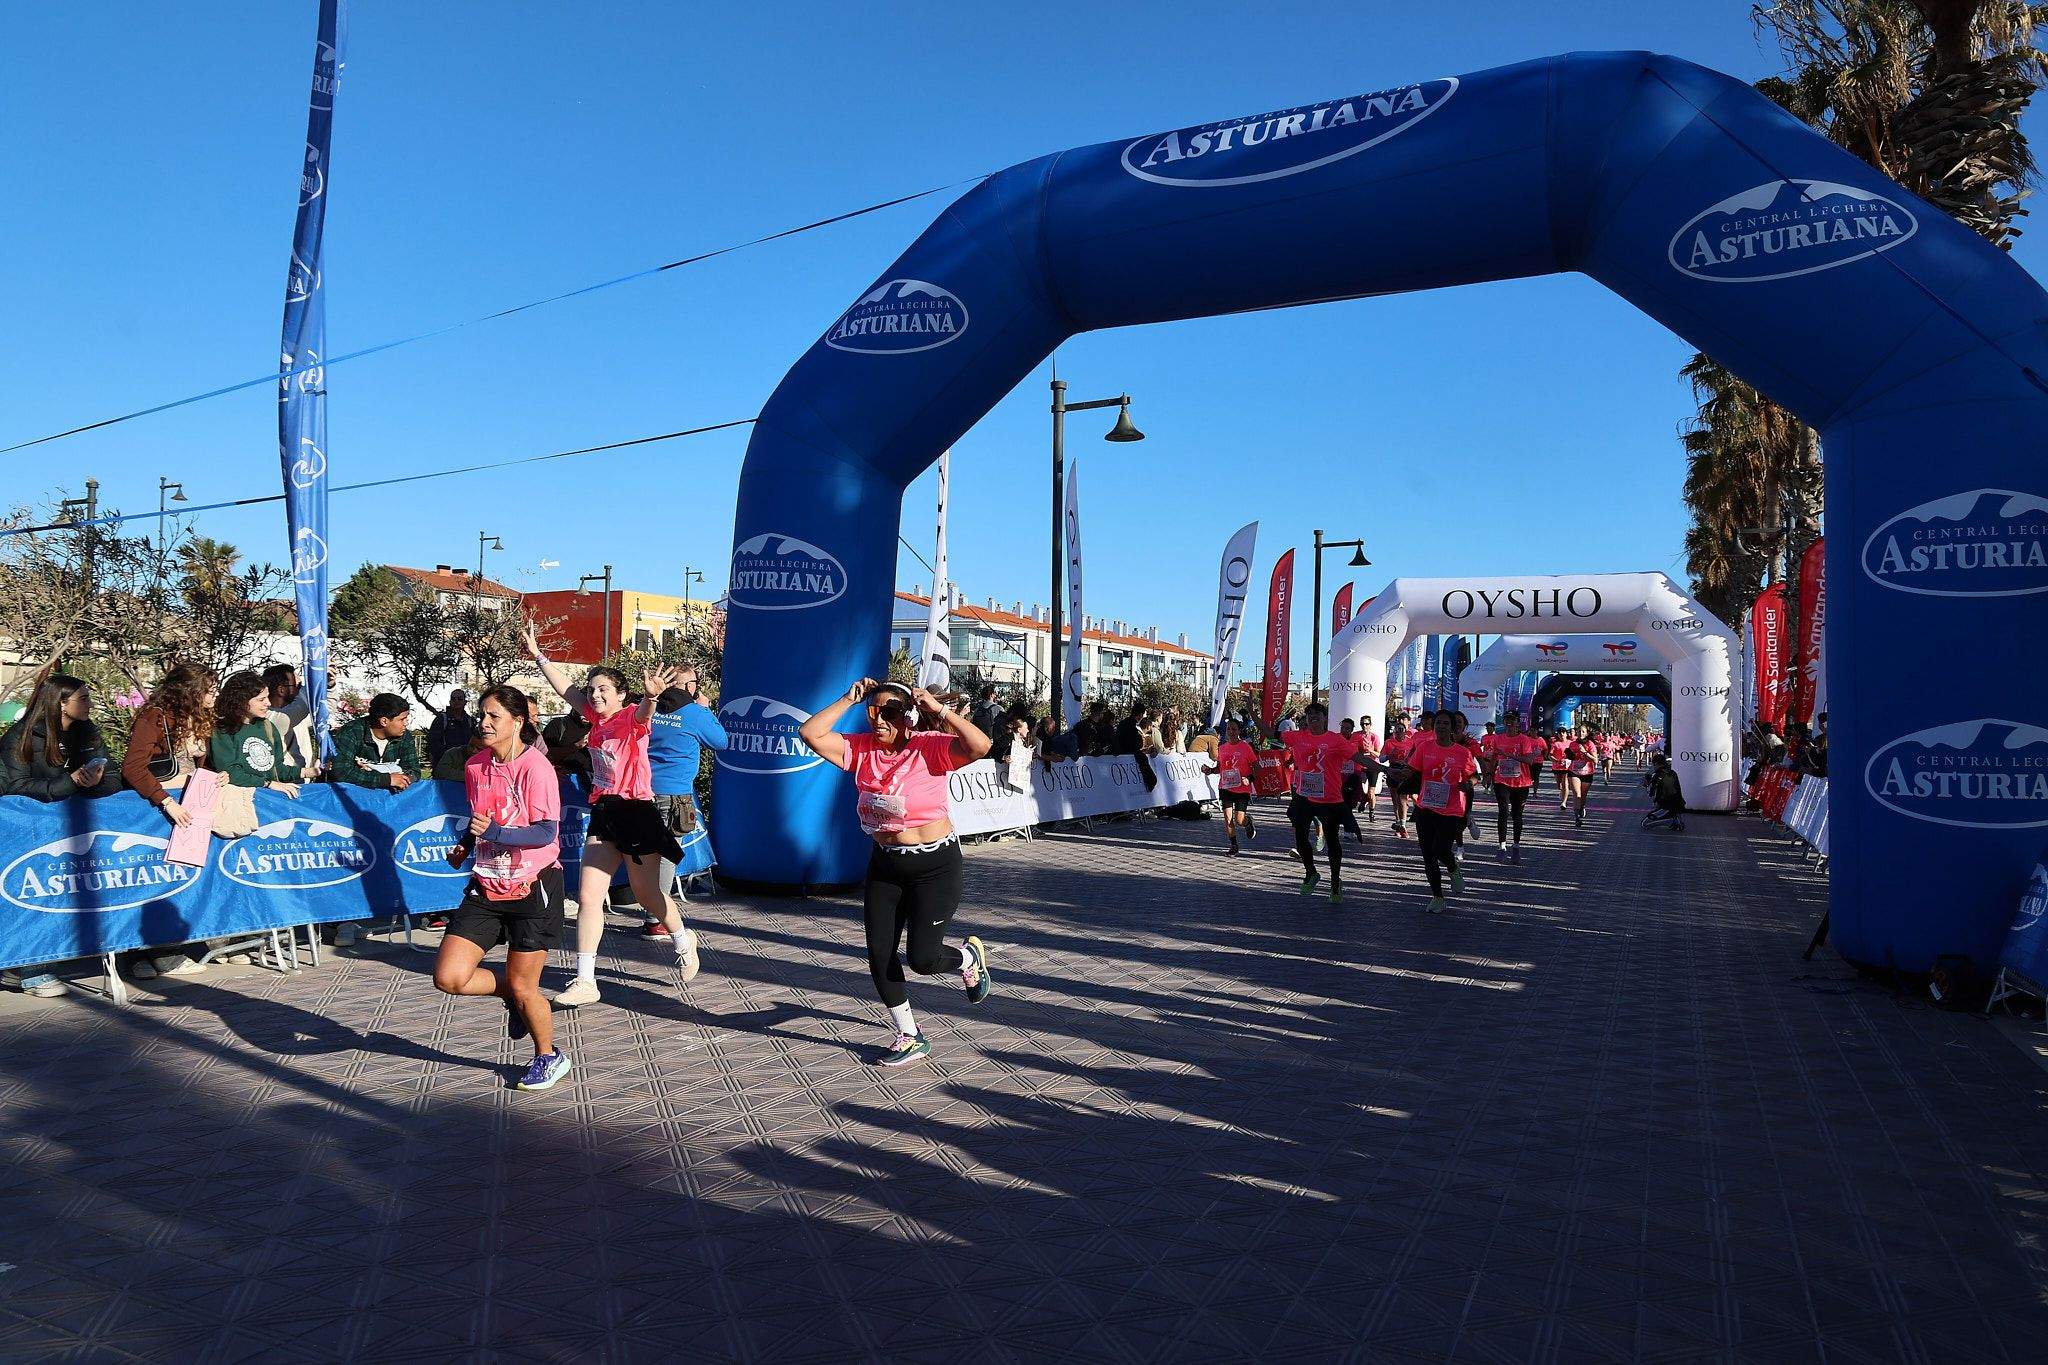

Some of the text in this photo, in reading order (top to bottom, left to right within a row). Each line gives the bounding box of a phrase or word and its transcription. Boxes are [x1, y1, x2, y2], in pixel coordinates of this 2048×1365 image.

[1140, 88, 1428, 169] ASTURIANA
[1721, 203, 1889, 232] CENTRAL LECHERA
[1688, 214, 1903, 269] ASTURIANA
[854, 300, 951, 317] CENTRAL LECHERA
[831, 312, 957, 340] ASTURIANA
[1913, 526, 1999, 540] CENTRAL
[739, 560, 832, 571] CENTRAL LECHERA
[1442, 587, 1602, 619] OYSHO
[1275, 575, 1287, 657] Santander
[1651, 619, 1704, 631] OYSHO
[1353, 624, 1397, 634] OYSHO
[1765, 606, 1779, 677] Santander
[1332, 682, 1373, 692] OYSHO
[1680, 685, 1730, 697] OYSHO
[724, 720, 801, 733] CENTRAL LECH
[725, 731, 821, 757] TURIAN
[1680, 750, 1730, 763] OYSHO
[1916, 755, 2048, 767] CENTRAL LEC
[1041, 764, 1094, 792] OYSHO
[1111, 763, 1142, 787] OYS
[1165, 758, 1201, 782] OYSHO
[949, 771, 1014, 803] OYSHO
[257, 842, 308, 851] CENTRAL
[419, 835, 458, 844] CENTRAL
[48, 858, 114, 872] CENTRAL
[234, 847, 369, 876] ASTURIANA
[18, 865, 190, 900] ASTURIANA
